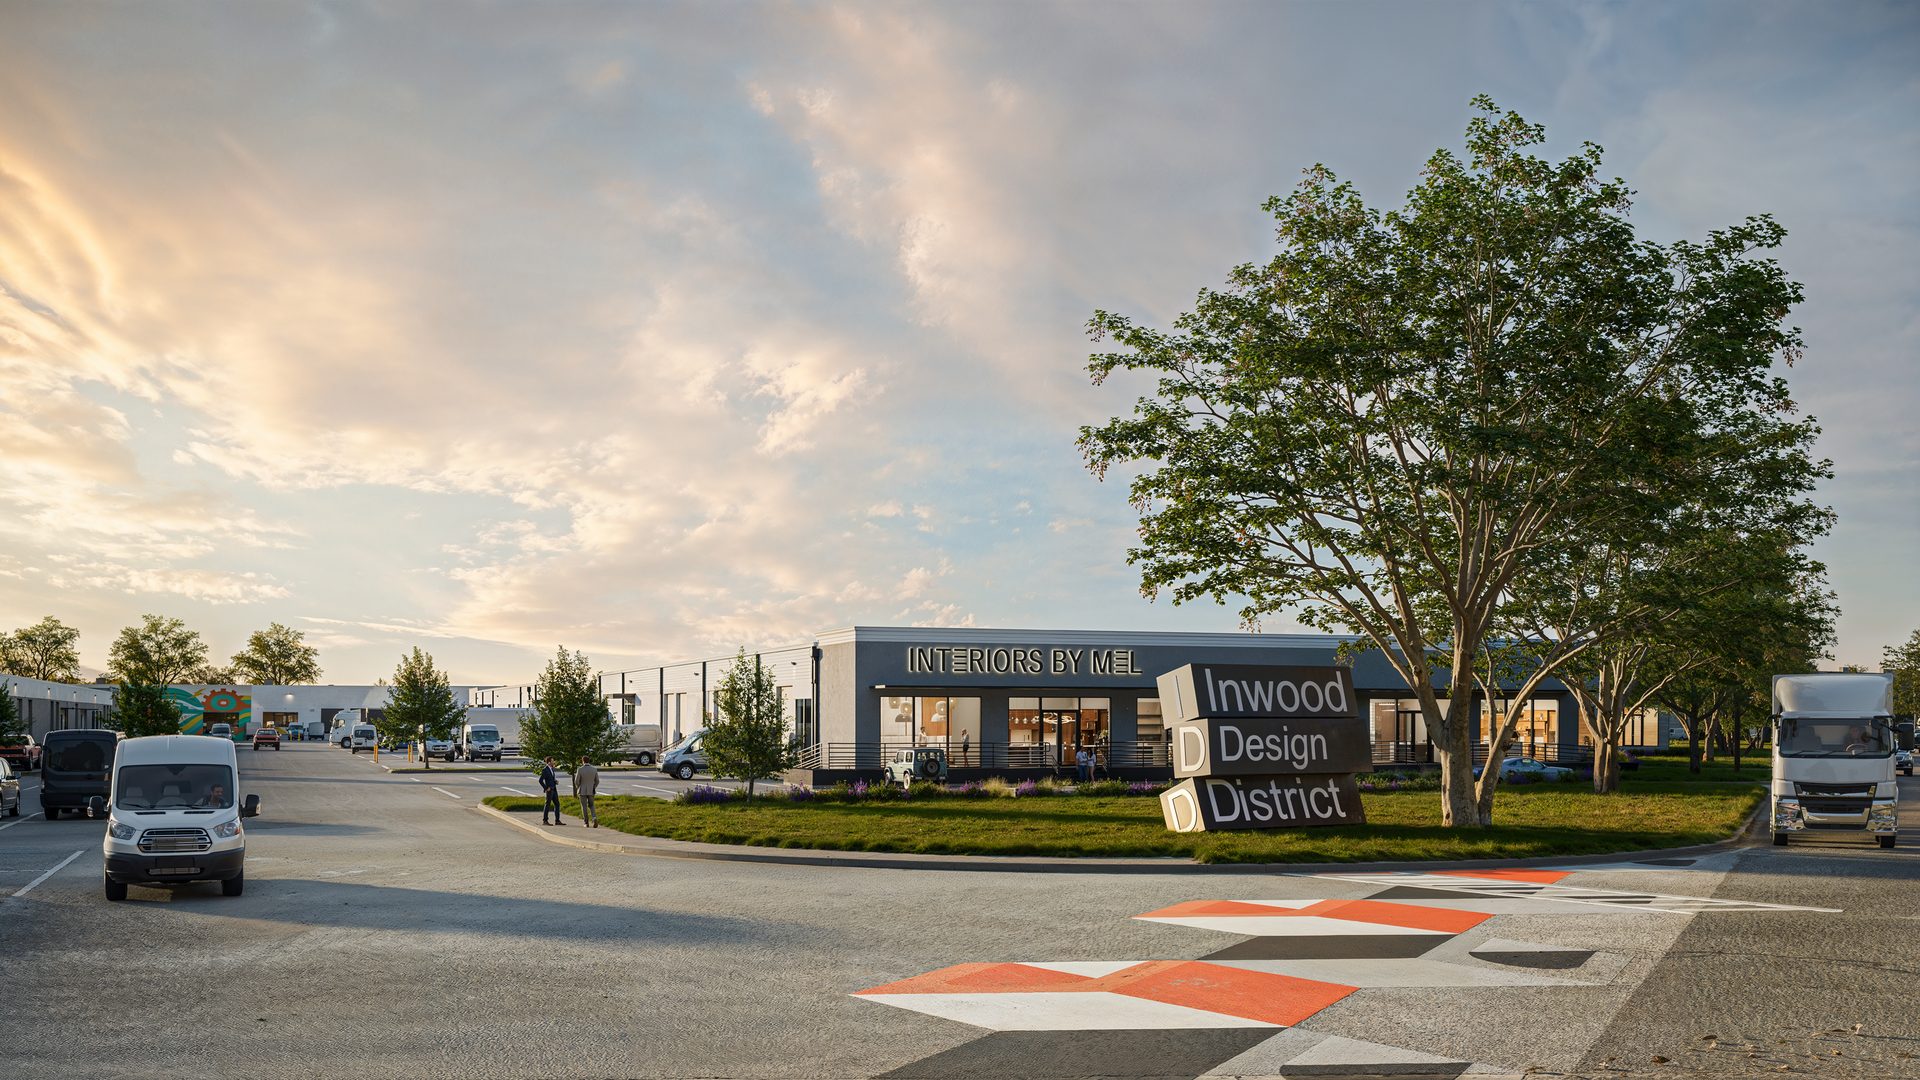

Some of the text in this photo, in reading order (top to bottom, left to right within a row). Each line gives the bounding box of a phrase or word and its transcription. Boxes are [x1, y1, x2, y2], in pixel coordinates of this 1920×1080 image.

[908, 647, 1142, 674] INTERIORS BY MEL
[1204, 668, 1348, 713] Inwood
[1179, 726, 1206, 772] D
[1219, 725, 1328, 770] Design
[1167, 788, 1197, 833] D
[1205, 777, 1347, 822] District
